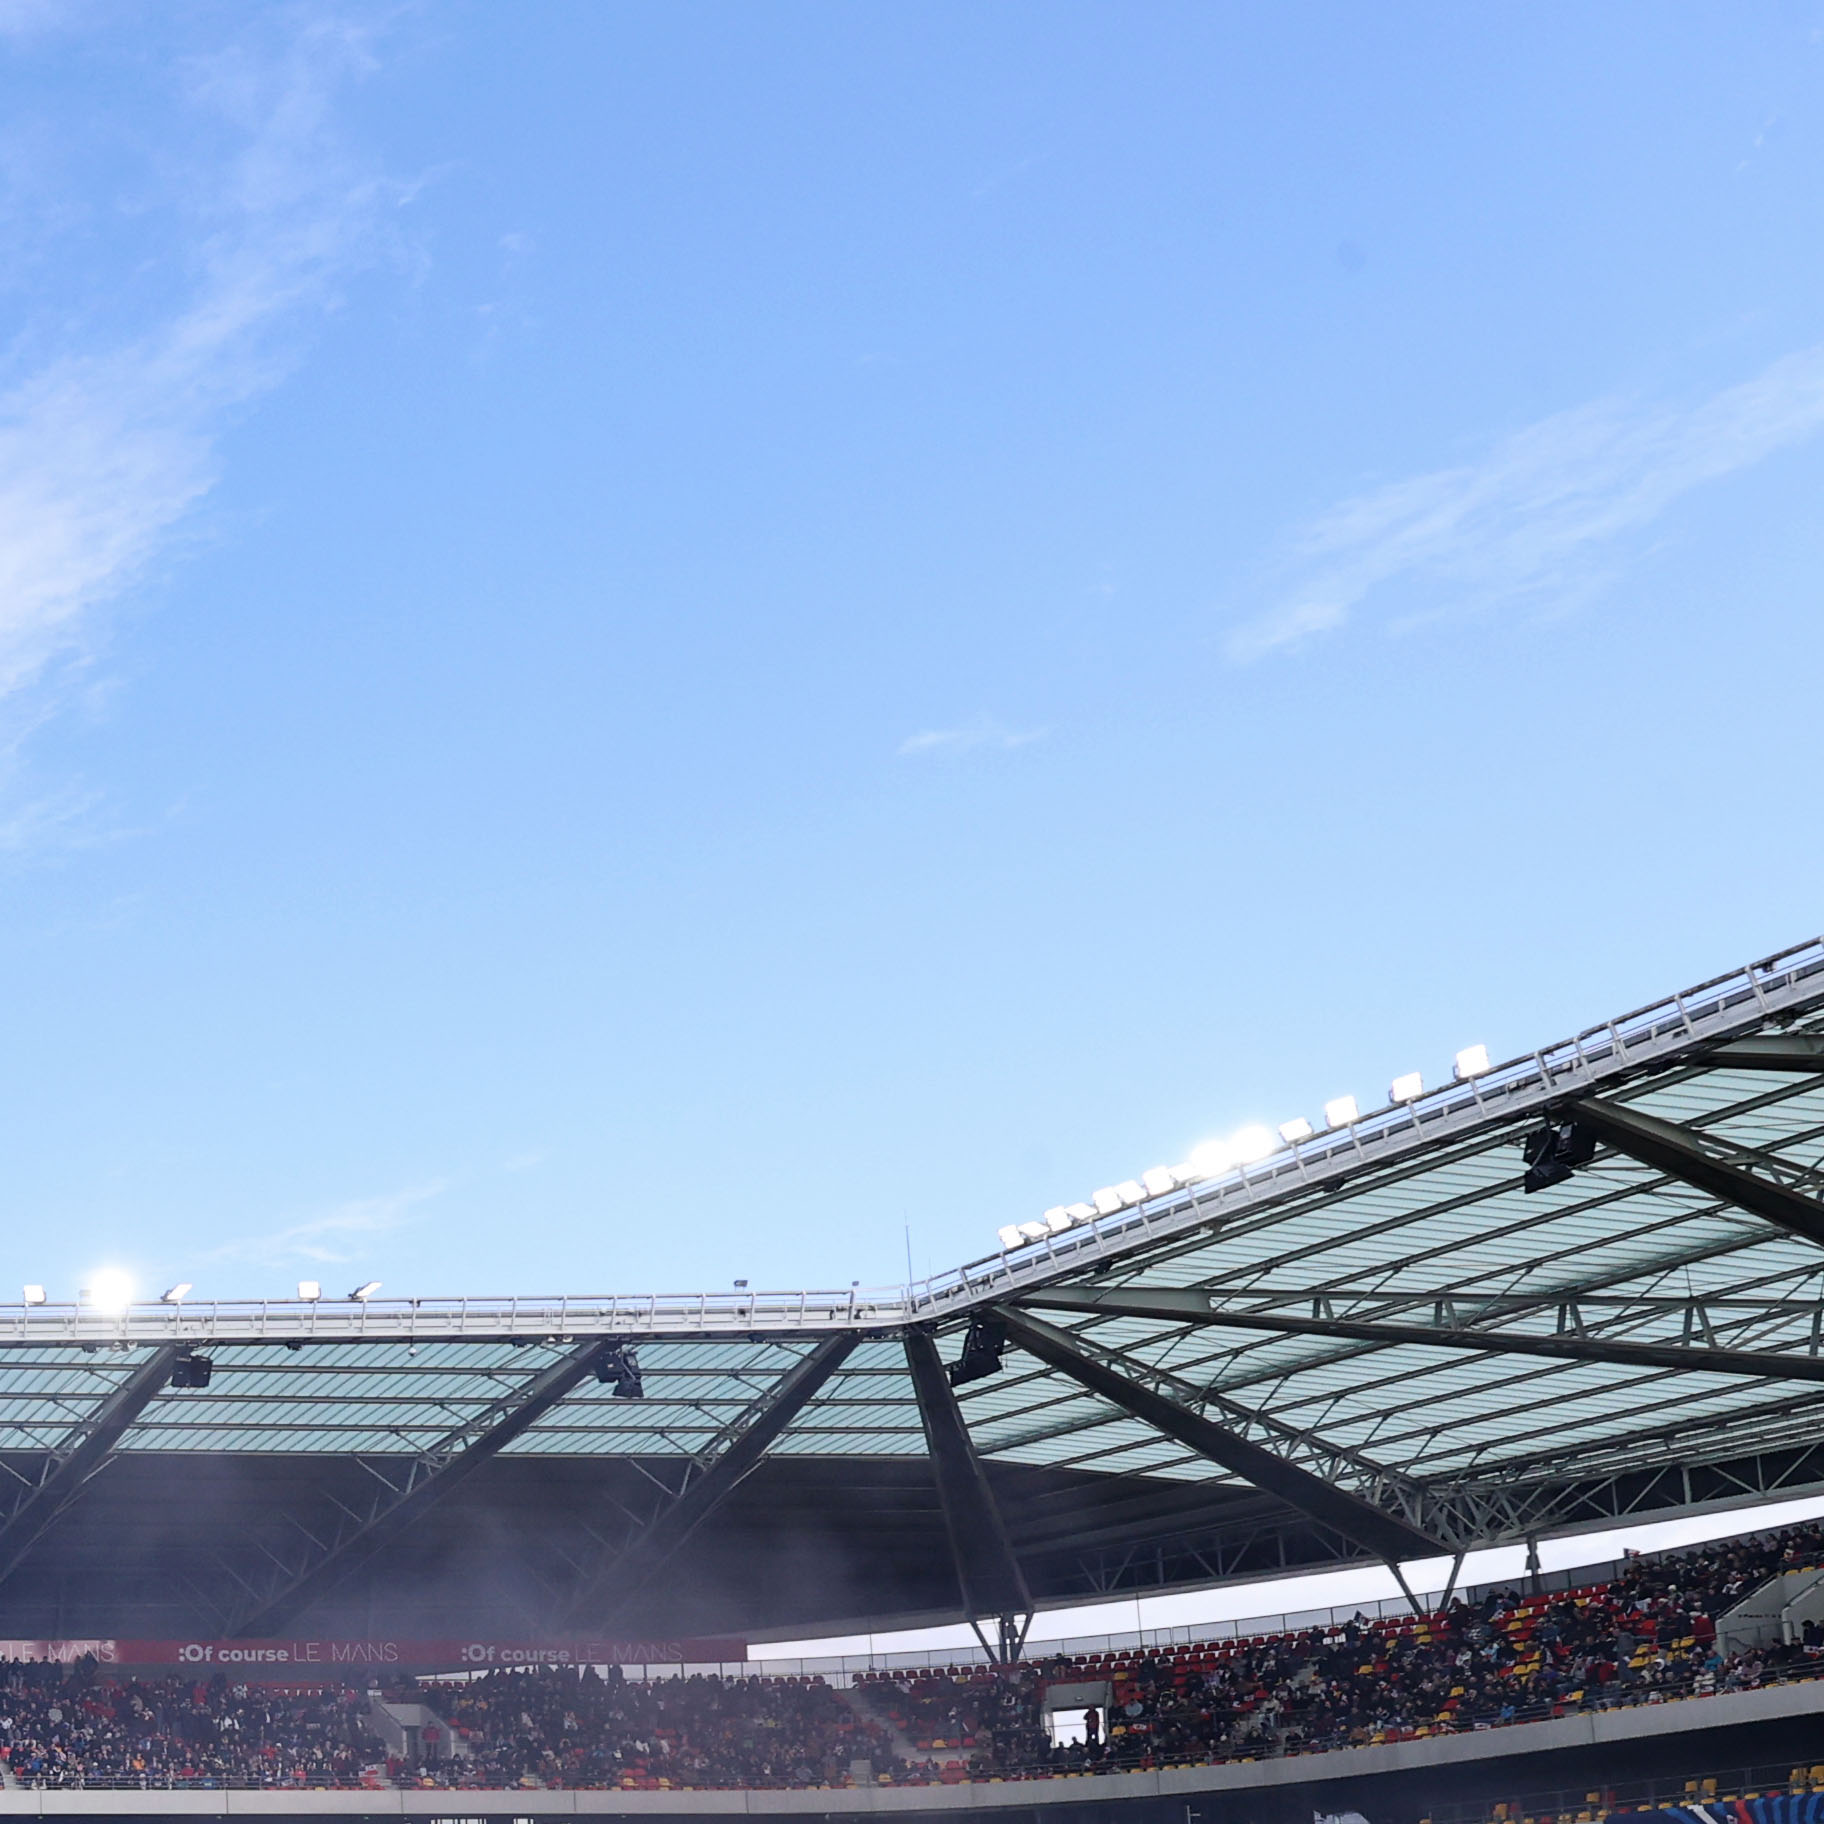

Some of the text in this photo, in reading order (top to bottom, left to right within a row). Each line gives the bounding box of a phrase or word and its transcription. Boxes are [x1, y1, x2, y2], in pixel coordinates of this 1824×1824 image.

[10, 1643, 36, 1662] LE
[218, 1649, 289, 1662] course
[294, 1642, 321, 1662] LE
[332, 1642, 399, 1662] MANS
[501, 1649, 569, 1661] course
[575, 1642, 601, 1661] LE
